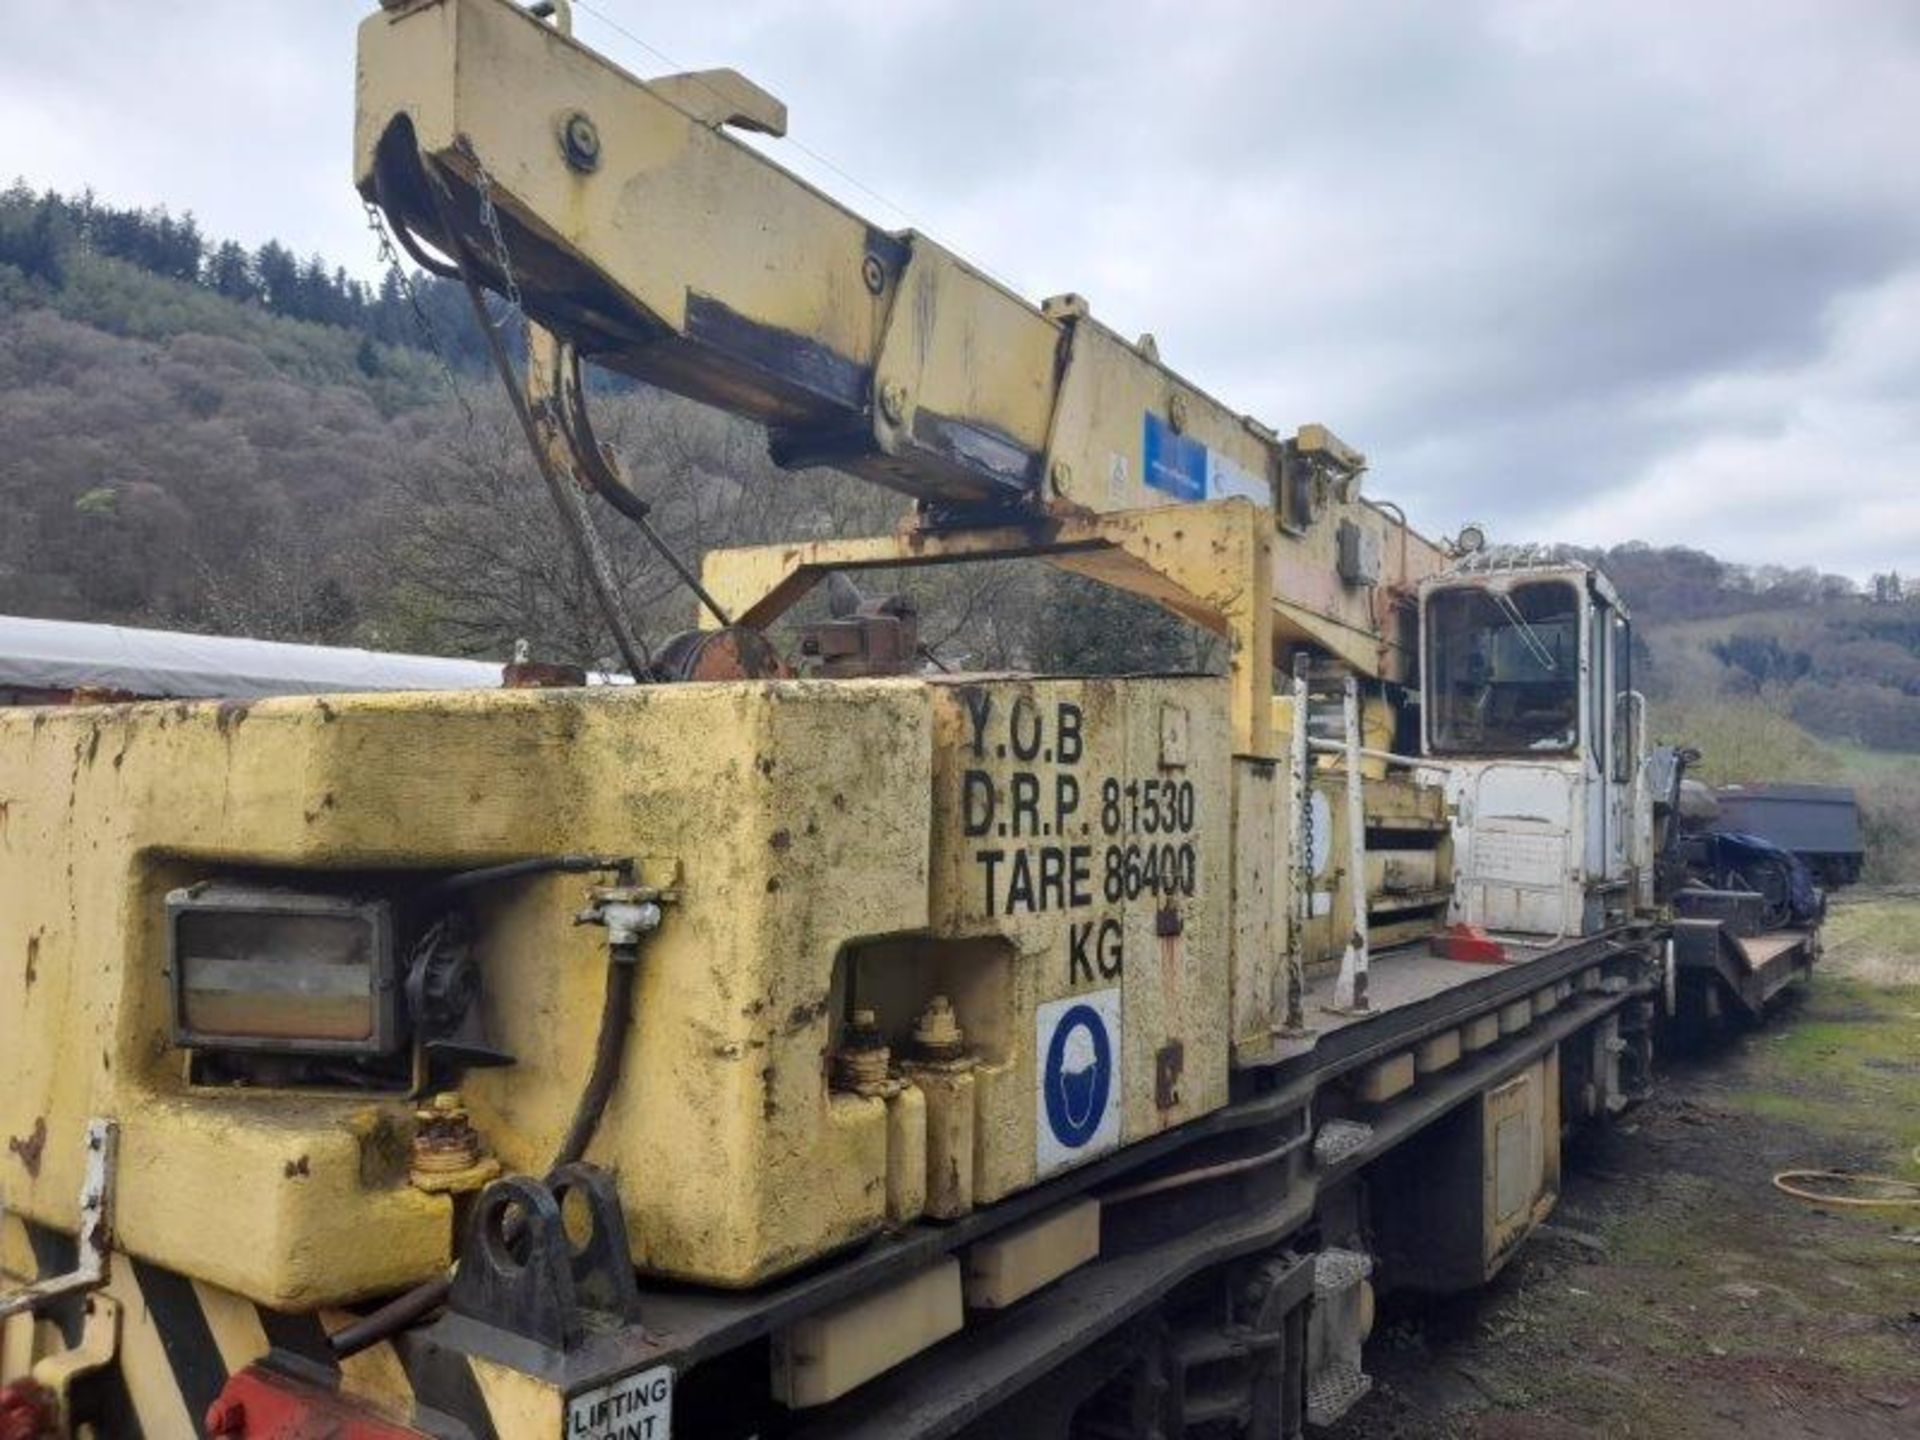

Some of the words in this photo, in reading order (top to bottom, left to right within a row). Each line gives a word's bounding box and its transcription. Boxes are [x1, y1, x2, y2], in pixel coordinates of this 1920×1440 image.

[964, 688, 1082, 762] Y.O.B
[963, 769, 1088, 838] D.R.P.
[1101, 776, 1194, 837] 81530
[977, 845, 1093, 916] TARE
[1103, 842, 1195, 902] 86400
[1069, 919, 1124, 985] KG
[574, 1380, 667, 1435] LIFTING
